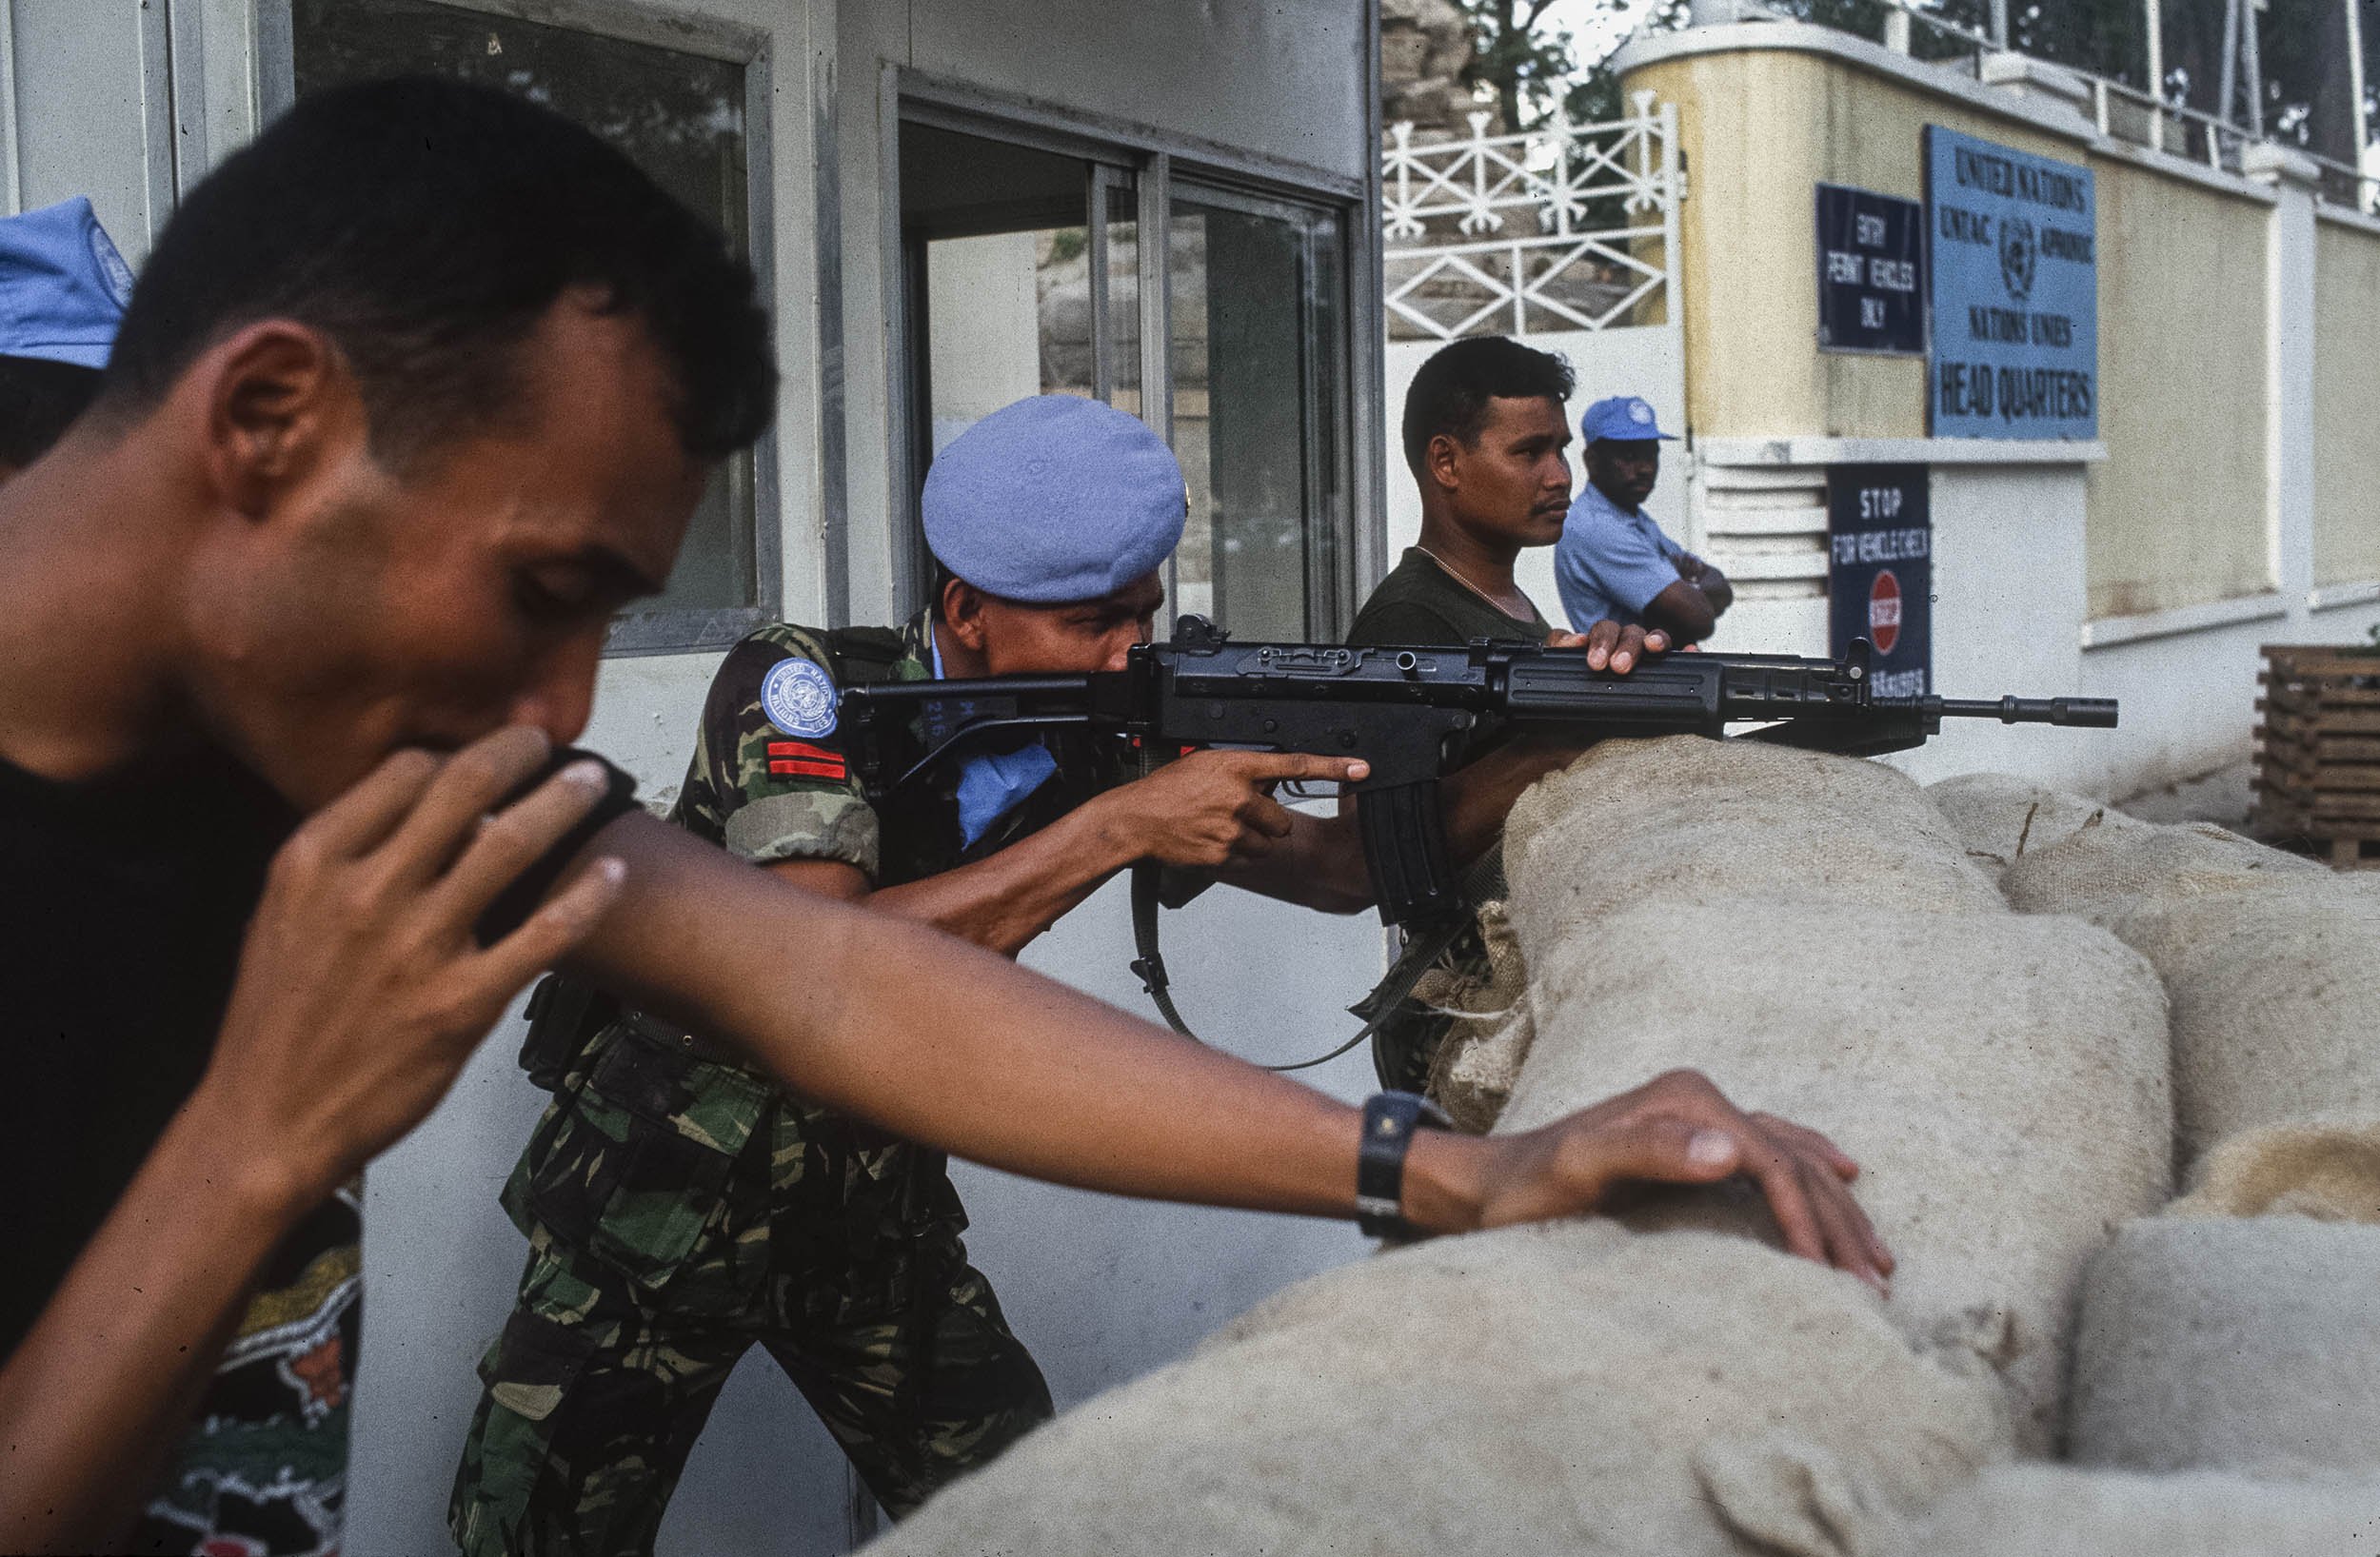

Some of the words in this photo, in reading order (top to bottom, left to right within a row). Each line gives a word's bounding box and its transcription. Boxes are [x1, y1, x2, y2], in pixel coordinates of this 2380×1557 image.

[1956, 148, 2013, 198] UNITED
[2018, 166, 2087, 214] NATIONS
[1969, 305, 2027, 345] NATIONS
[1940, 363, 1993, 418] HEAD
[1998, 365, 2092, 424] QUARTERS
[1859, 487, 1902, 519] STOP
[777, 664, 805, 681] UNITED
[770, 694, 800, 726] NATIONS
